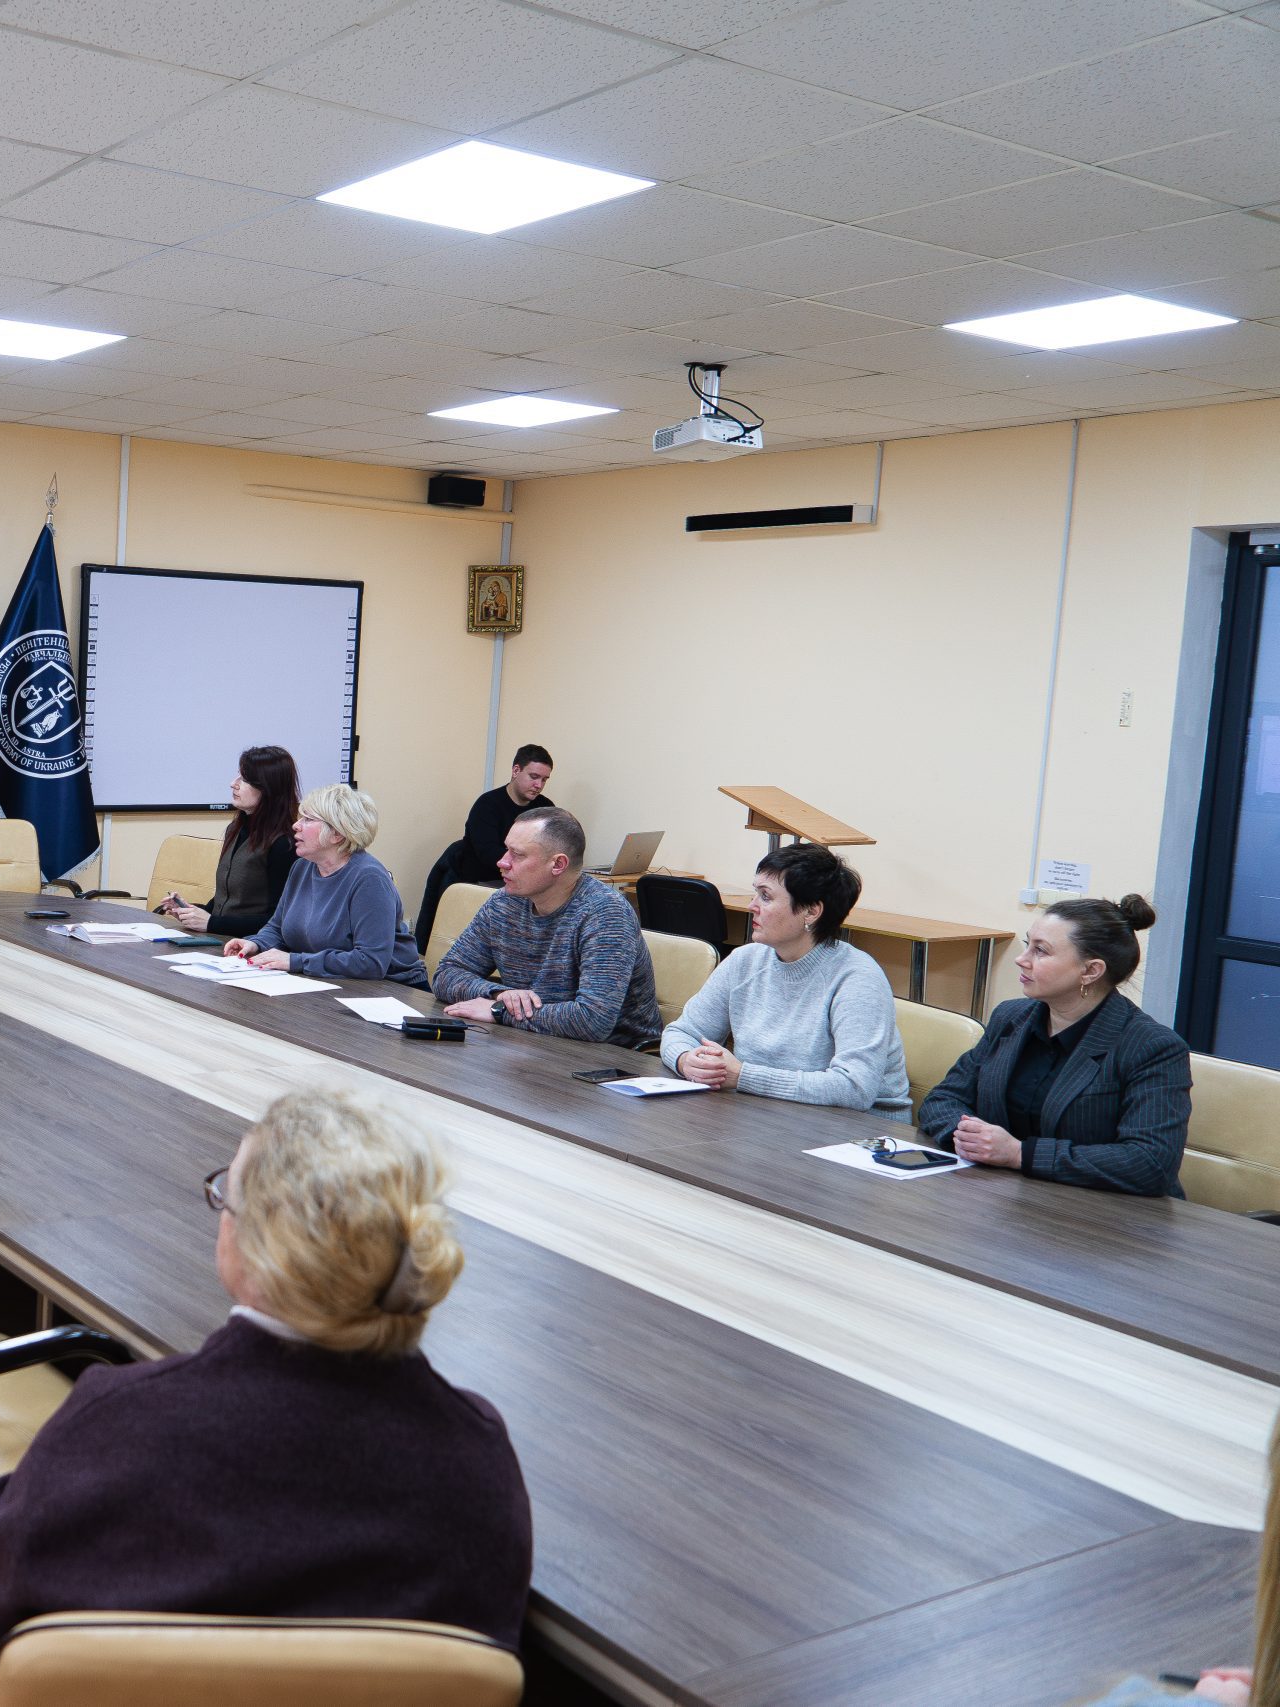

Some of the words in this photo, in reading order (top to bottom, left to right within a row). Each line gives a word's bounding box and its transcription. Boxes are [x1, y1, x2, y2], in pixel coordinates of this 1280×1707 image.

[10, 736, 19, 746] AD
[21, 746, 46, 758] ASTRA
[20, 757, 33, 767] OF
[34, 757, 76, 771] UKRAINE
